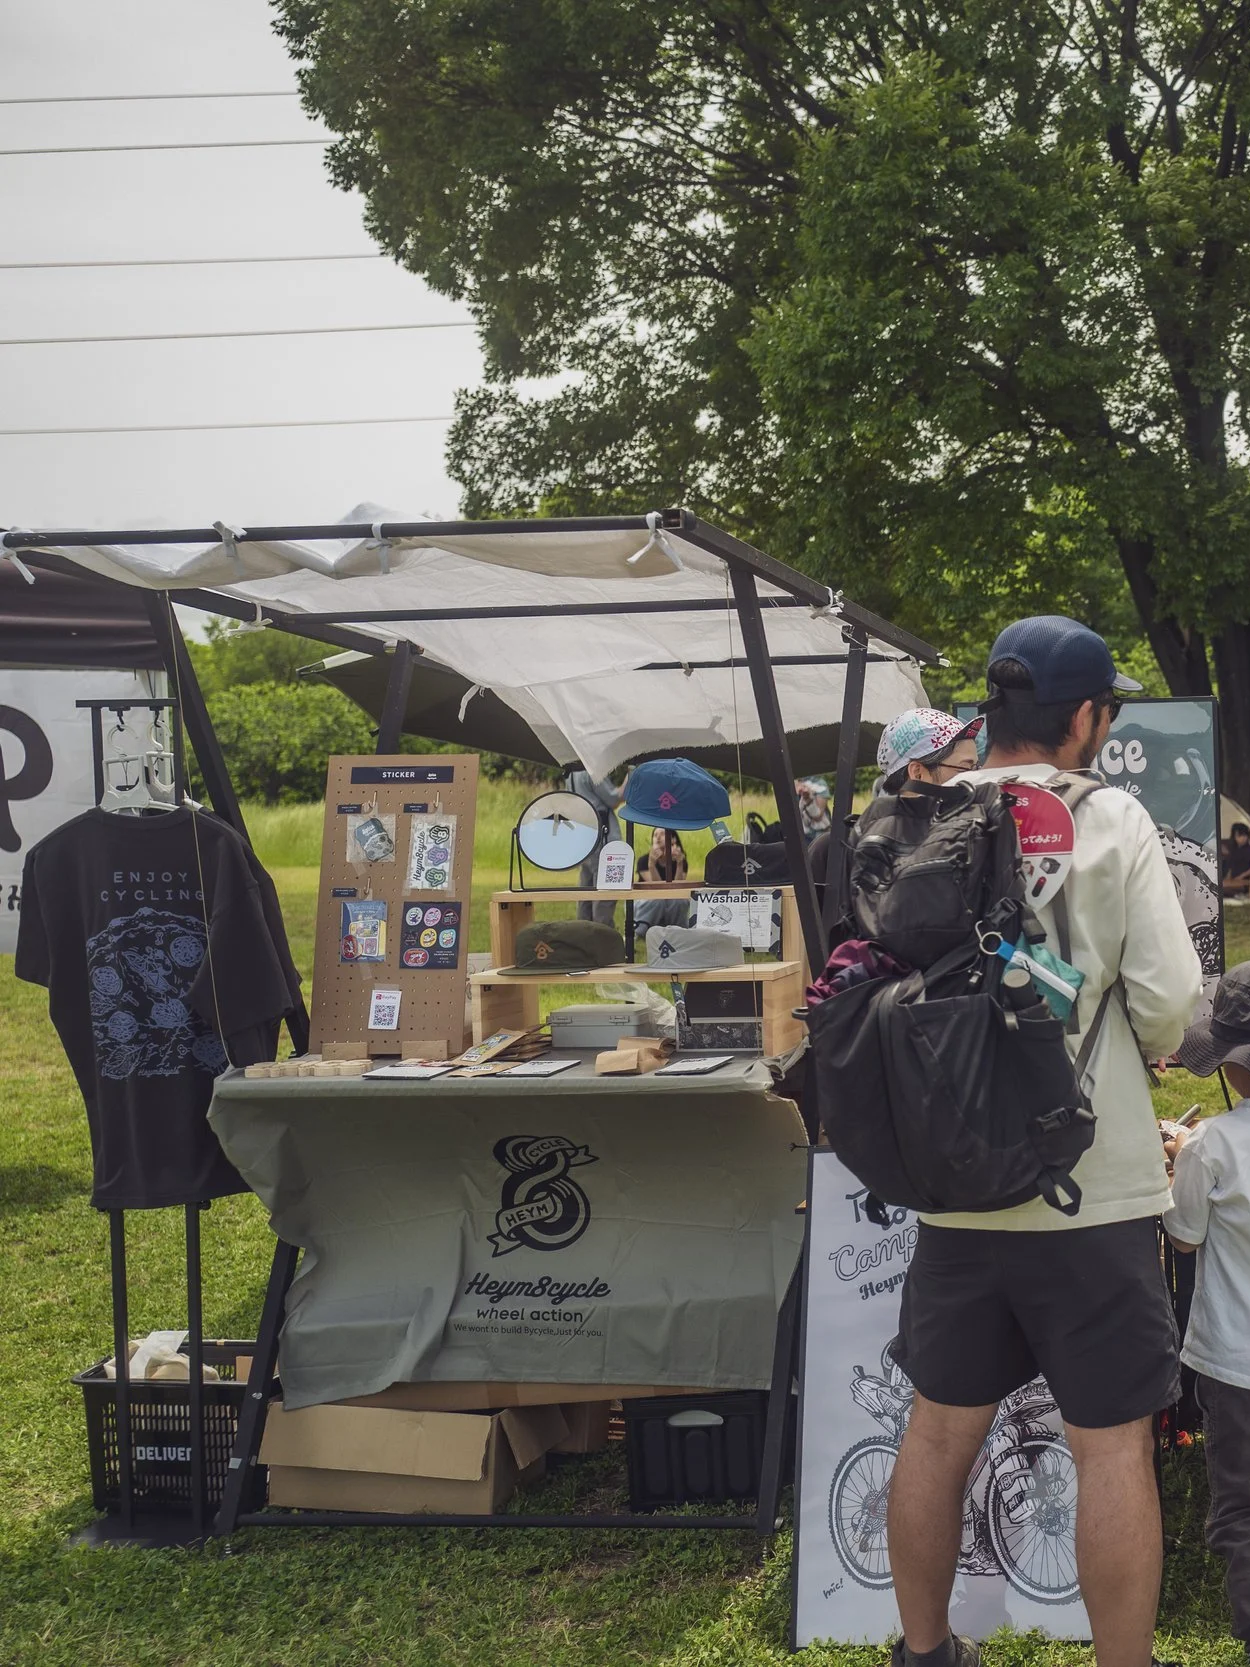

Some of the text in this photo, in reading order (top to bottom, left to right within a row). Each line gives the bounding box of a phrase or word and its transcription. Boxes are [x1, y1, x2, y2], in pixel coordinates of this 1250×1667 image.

[1091, 739, 1147, 776] ce
[113, 871, 188, 883] ENJOY
[100, 889, 205, 902] CYCLING
[698, 890, 758, 904] Washable
[529, 1138, 566, 1159] CYCLE
[505, 1202, 549, 1227] HEYM
[464, 1272, 612, 1305] Heym8cycle
[476, 1308, 583, 1323] wheel action
[501, 1325, 522, 1334] build
[586, 1329, 604, 1338] you.
